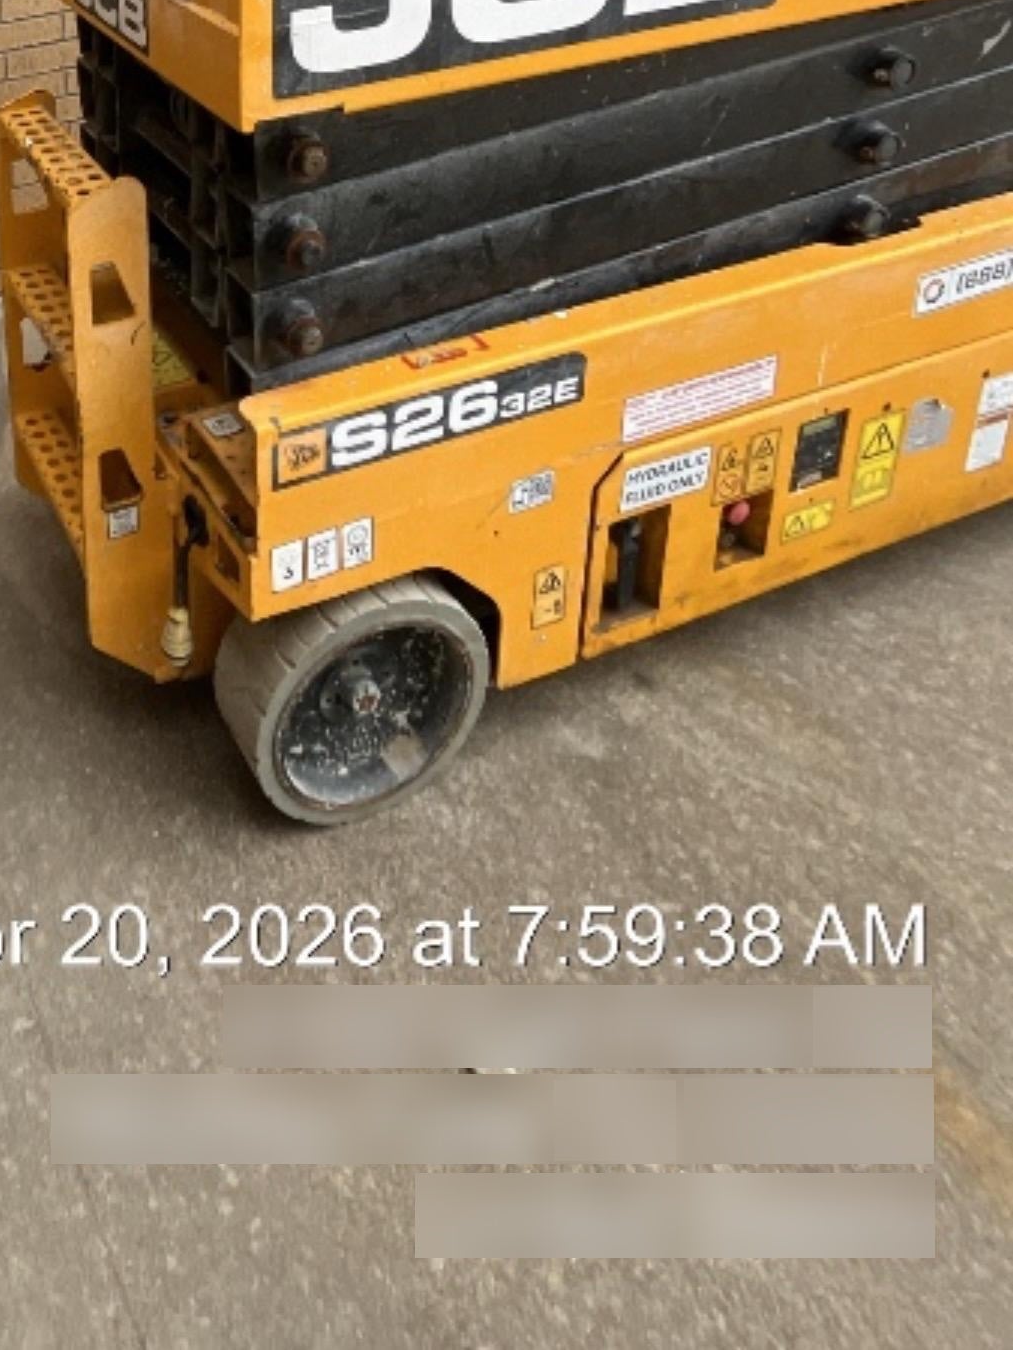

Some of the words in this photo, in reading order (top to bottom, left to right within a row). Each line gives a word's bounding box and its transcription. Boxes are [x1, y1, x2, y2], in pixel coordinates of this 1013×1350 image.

[628, 452, 709, 484] HYDRAULIC
[625, 482, 667, 504] FLUID
[668, 470, 705, 493] ONLY
